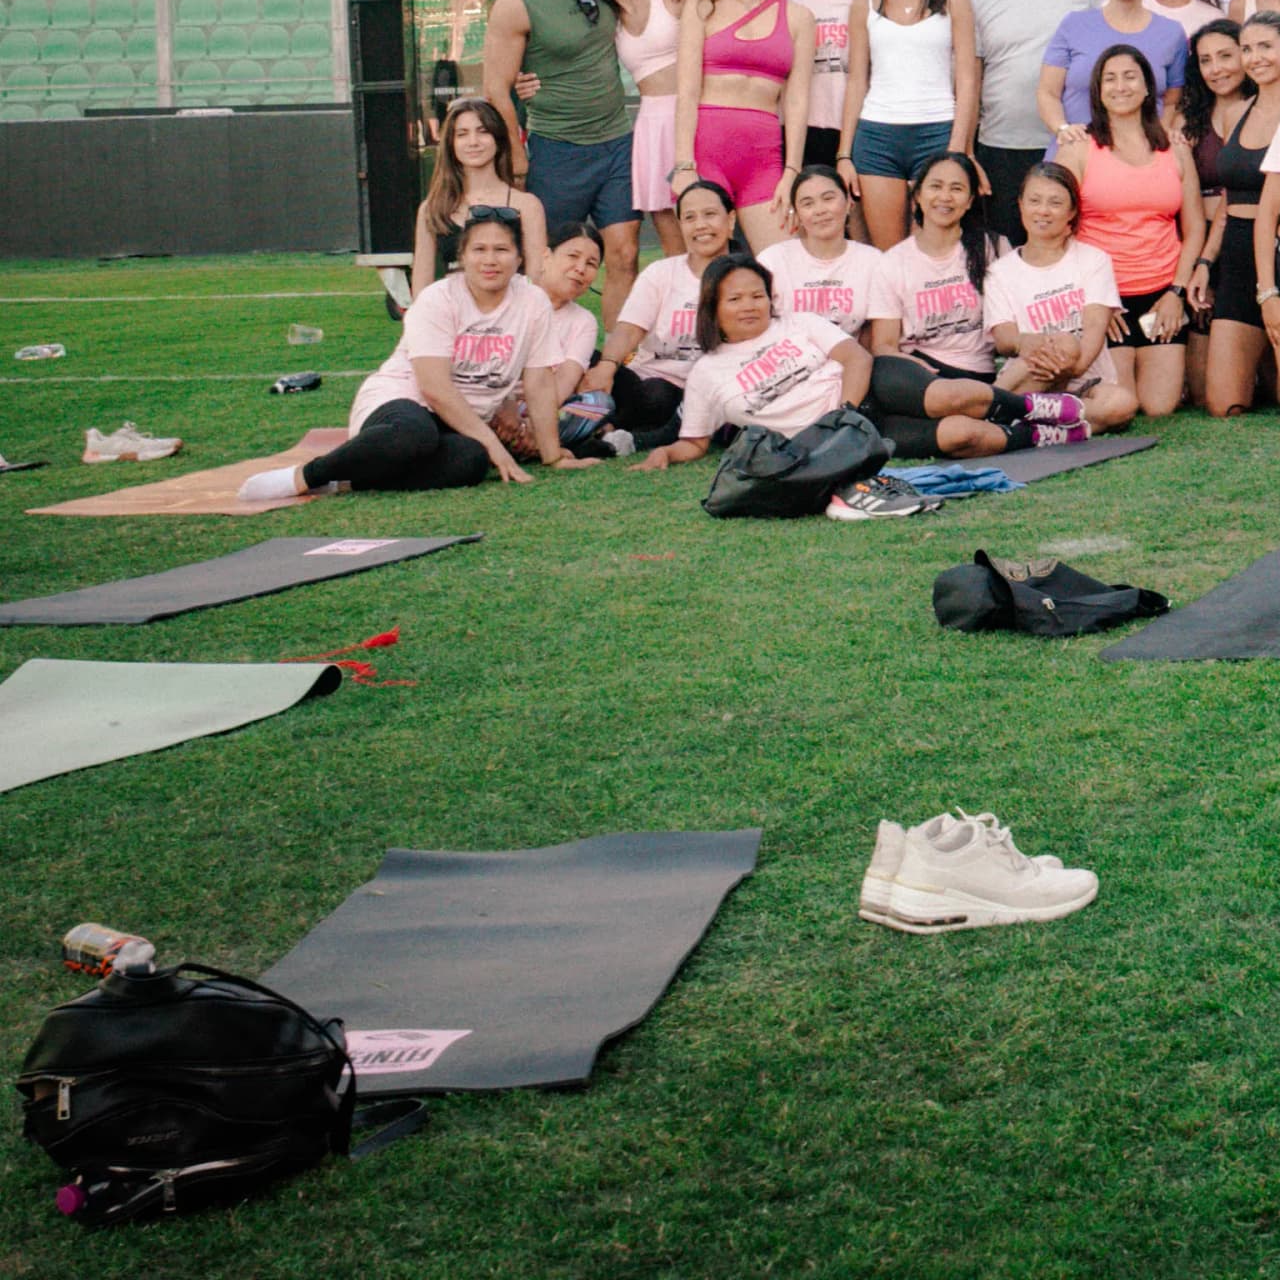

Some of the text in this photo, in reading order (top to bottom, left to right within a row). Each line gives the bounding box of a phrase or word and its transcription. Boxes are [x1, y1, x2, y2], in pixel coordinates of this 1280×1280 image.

[794, 287, 854, 315] FITNESS
[915, 282, 978, 321] FITNESS
[451, 333, 513, 364] FITNESS
[736, 338, 804, 393] FITNESS
